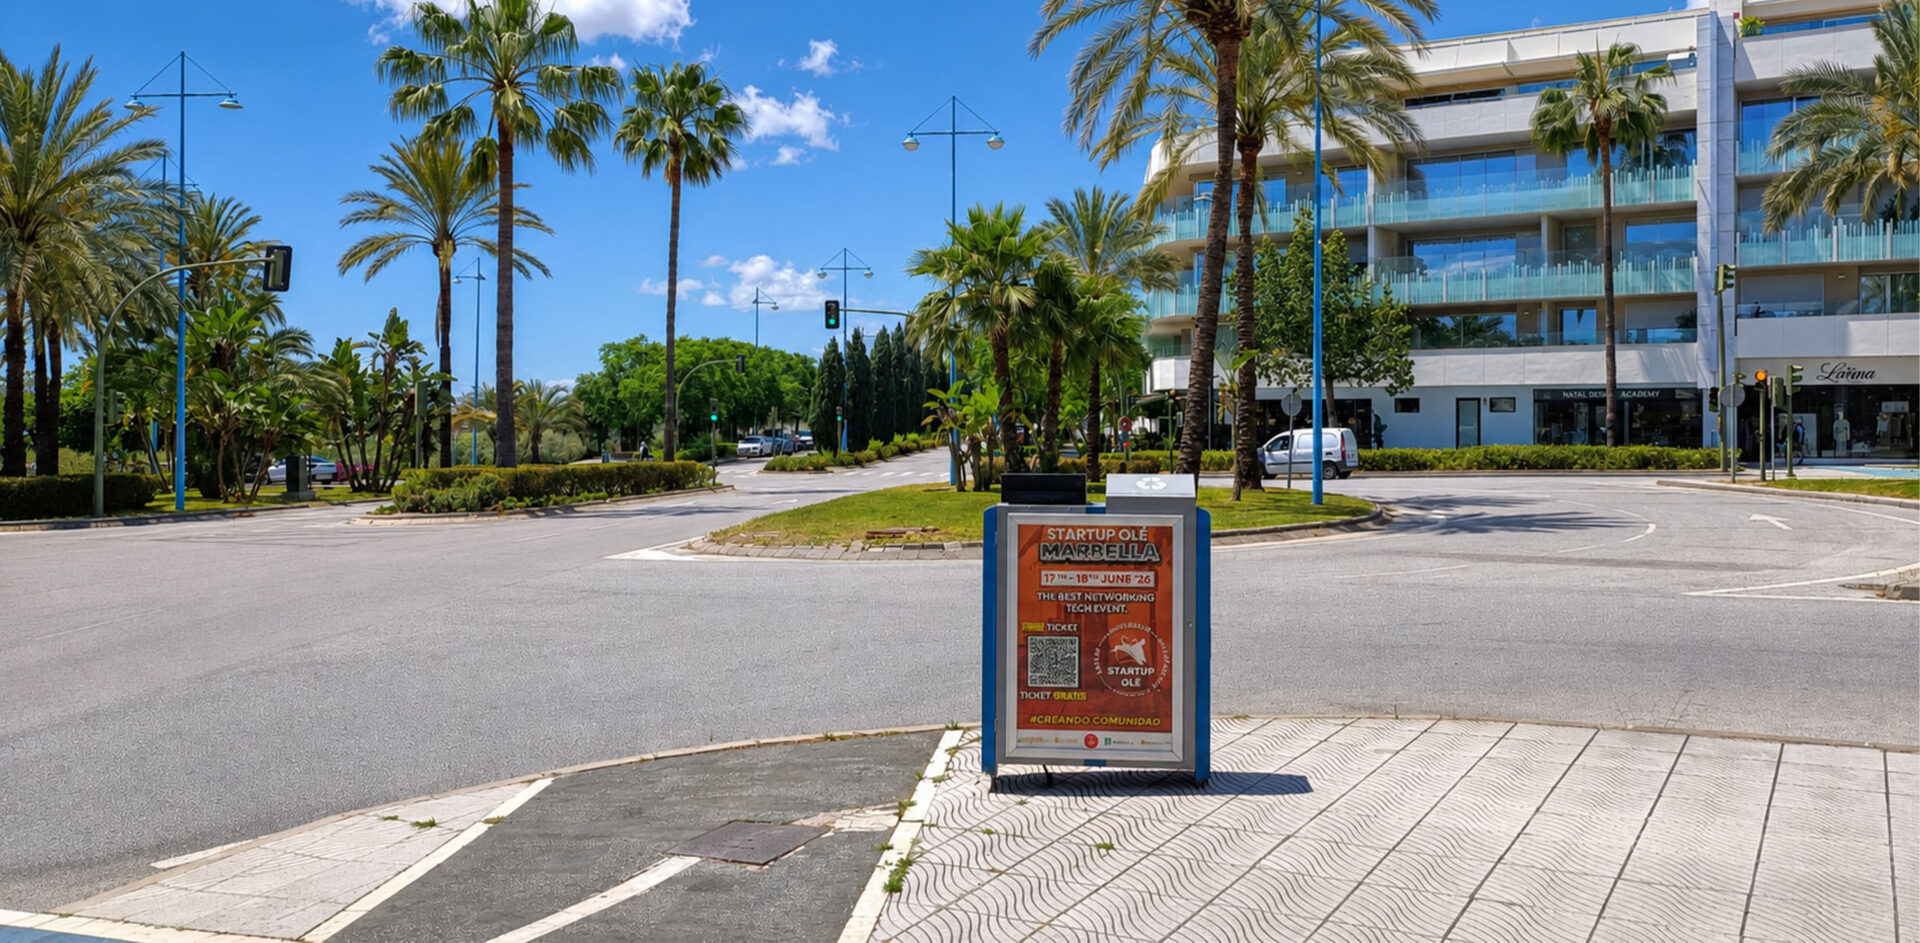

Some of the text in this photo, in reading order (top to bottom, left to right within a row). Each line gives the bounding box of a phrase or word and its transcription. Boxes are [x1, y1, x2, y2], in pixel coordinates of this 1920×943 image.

[1619, 390, 1661, 398] ACADEMY
[1047, 525, 1148, 541] STARTUP OLÉ
[1040, 543, 1160, 561] MARBELLA
[1101, 574, 1132, 584] JUNE
[1037, 591, 1155, 602] THE BEST NETWORKING
[1066, 604, 1092, 613] TECH
[1046, 623, 1079, 632] TICKET
[1107, 666, 1155, 676] STARTUP
[1020, 691, 1051, 700] TICKET
[1030, 715, 1161, 726] #CREANDO COMUNIDAD
